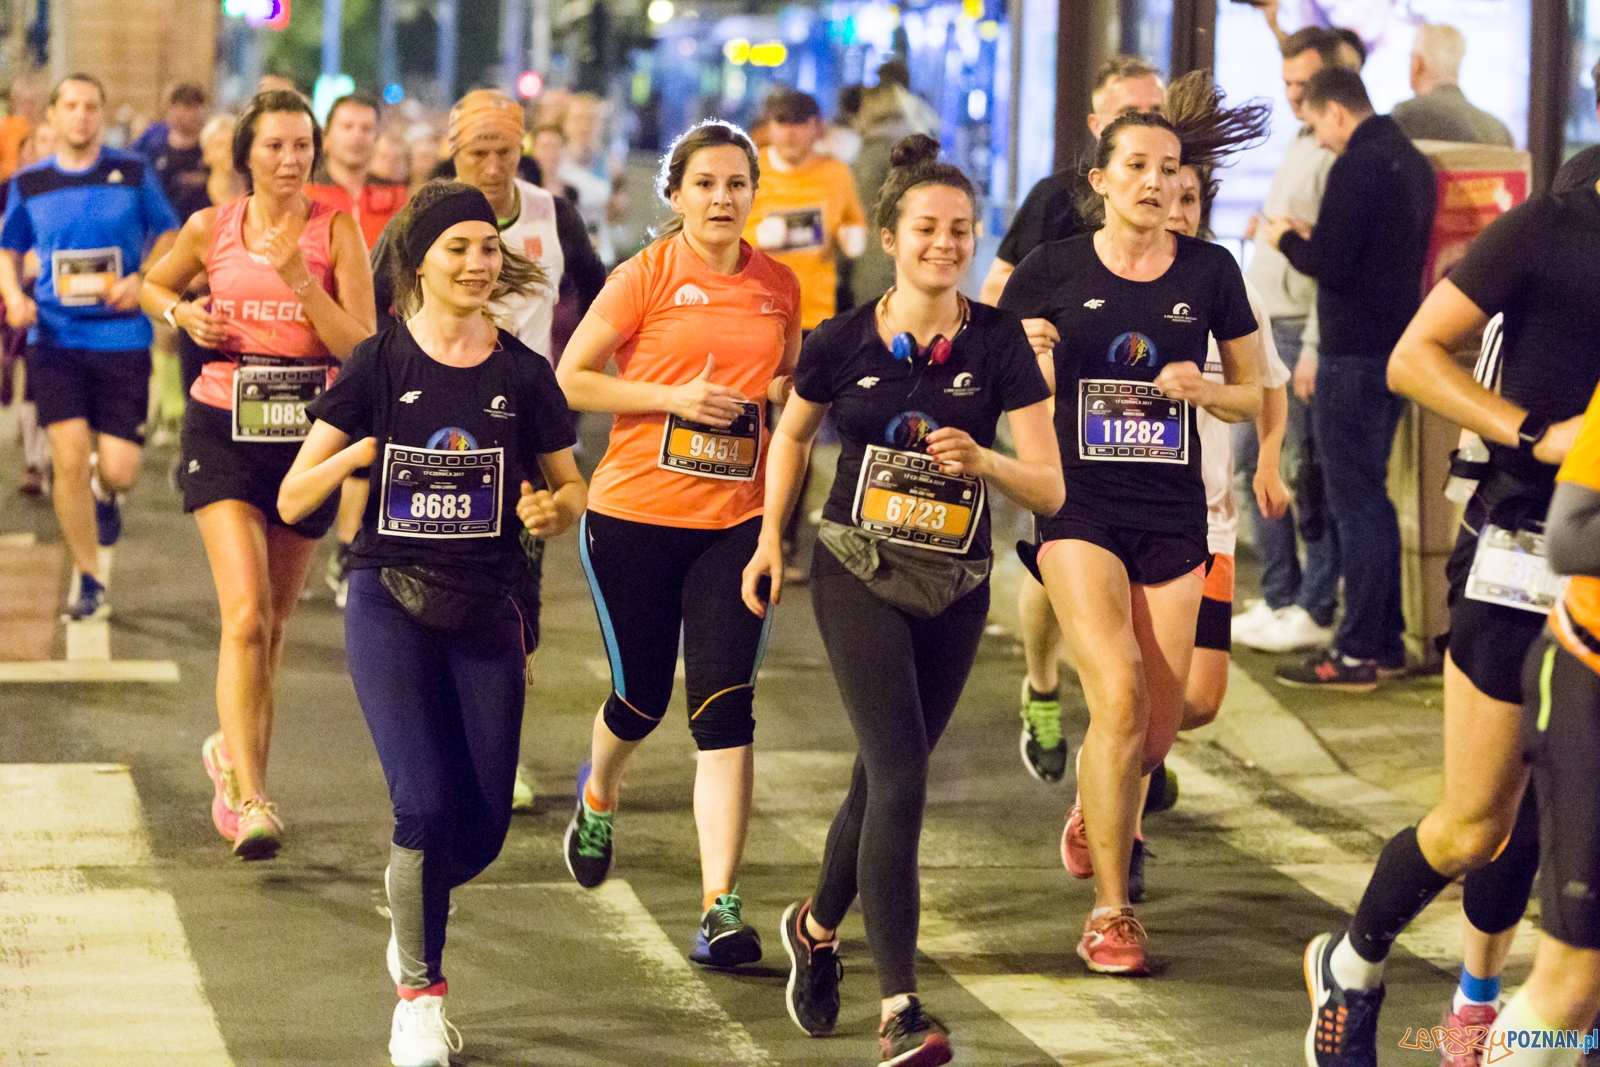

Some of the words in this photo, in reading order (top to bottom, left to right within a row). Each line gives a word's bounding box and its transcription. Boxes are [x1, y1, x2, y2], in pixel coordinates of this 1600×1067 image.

[1083, 298, 1105, 310] 4F
[857, 376, 880, 389] 4F
[399, 390, 422, 404] 4F
[262, 403, 306, 425] 1083
[1103, 419, 1165, 445] 11282
[690, 434, 739, 462] 9454
[410, 492, 471, 519] 8683
[886, 495, 947, 530] 6723
